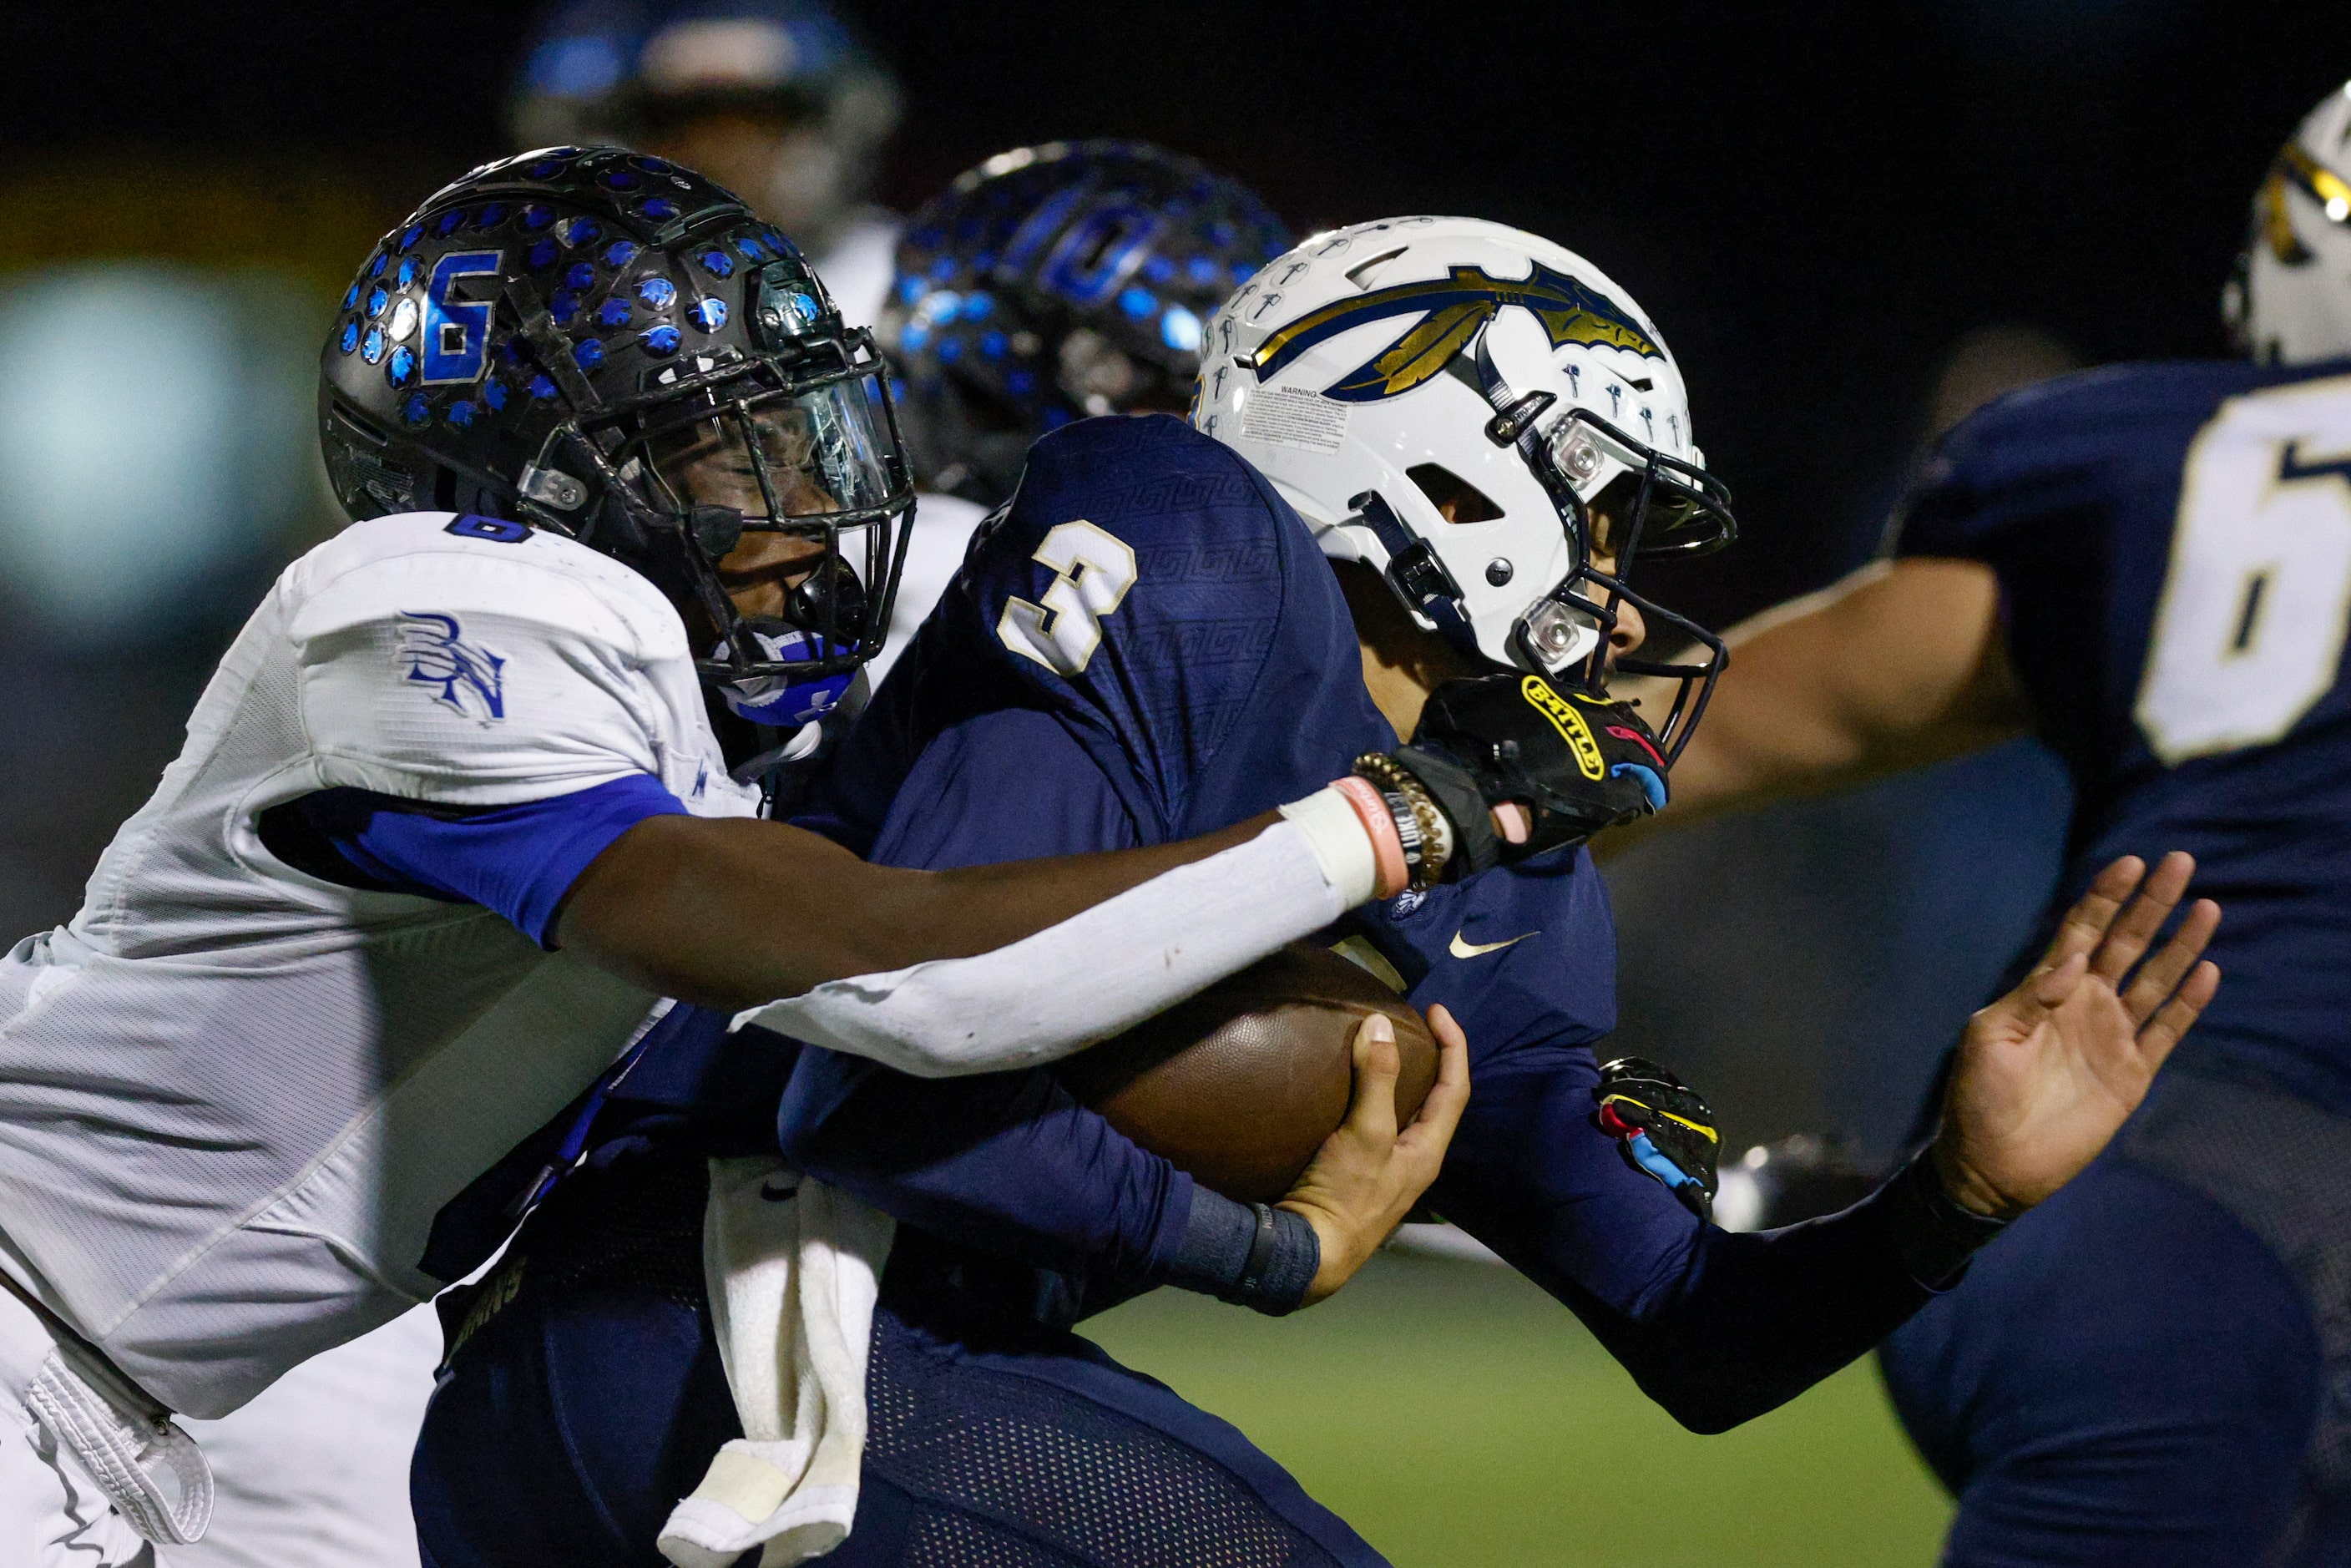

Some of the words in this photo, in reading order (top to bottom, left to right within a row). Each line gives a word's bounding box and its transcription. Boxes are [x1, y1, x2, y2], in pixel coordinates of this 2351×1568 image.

[421, 250, 505, 386] 6
[1282, 386, 1317, 398] WARNING
[996, 519, 1138, 677] 3
[1527, 683, 1600, 770] BATTLE
[1395, 814, 1422, 847] LUKE
